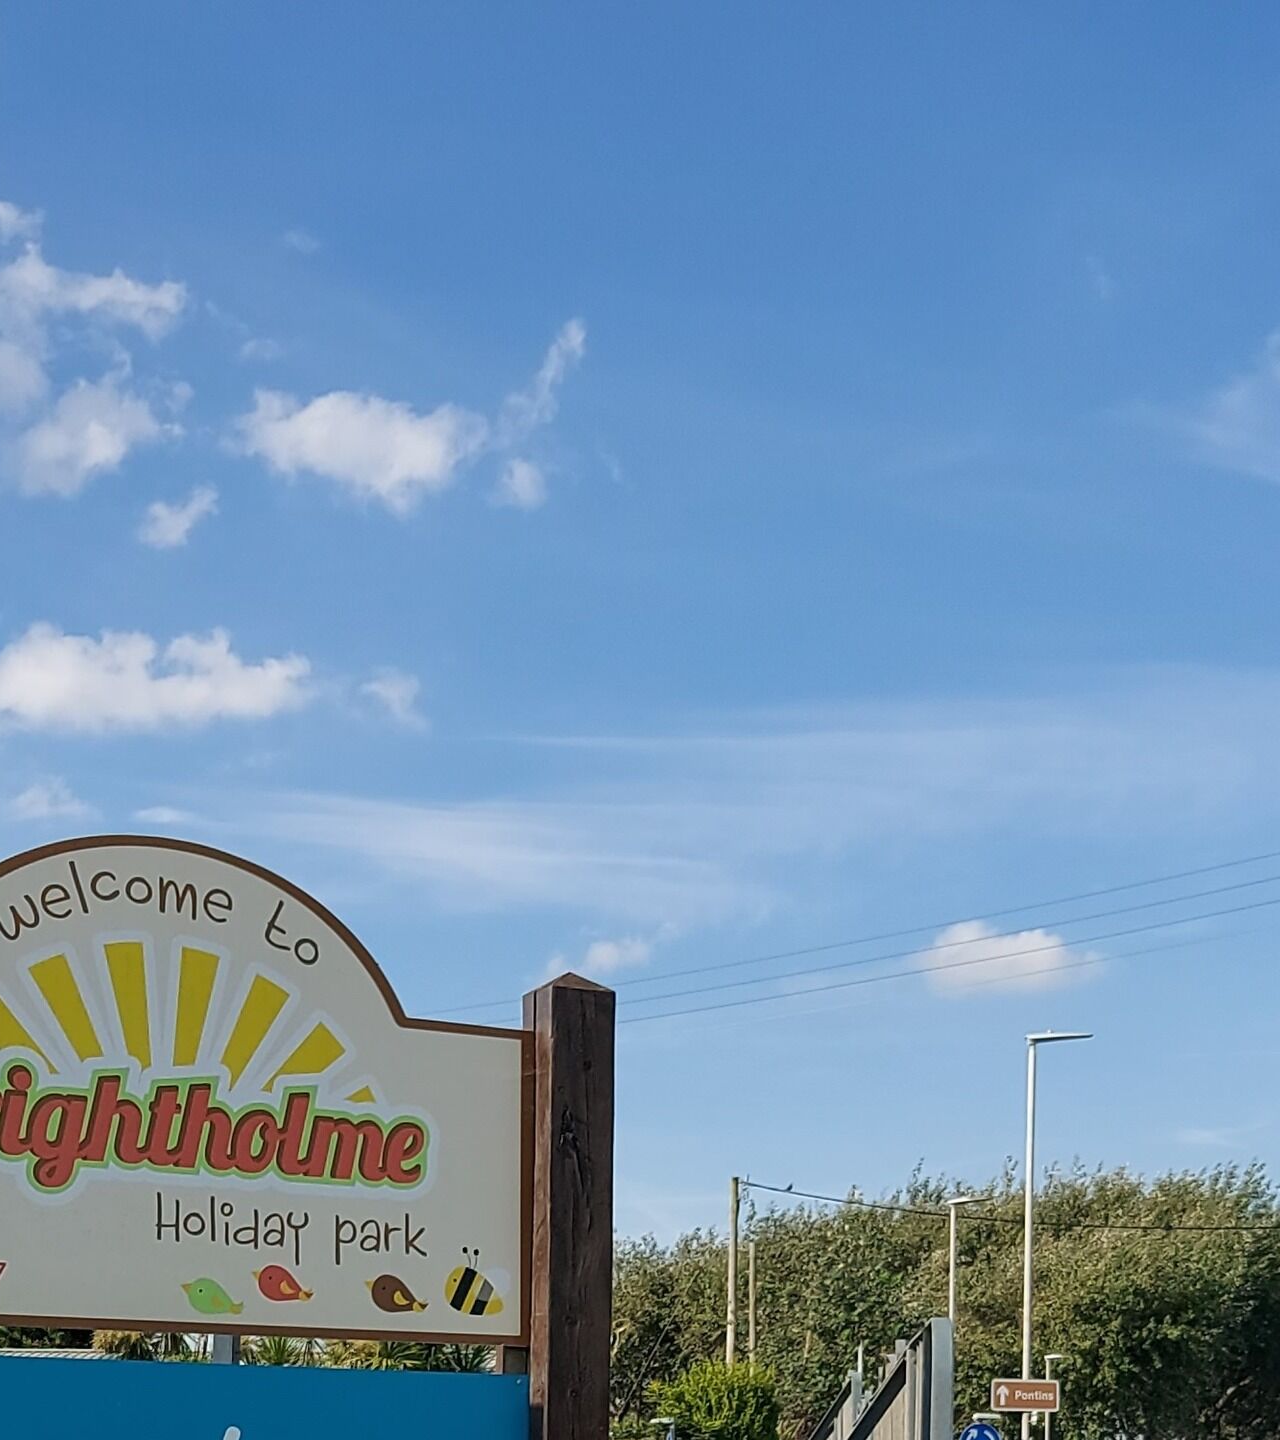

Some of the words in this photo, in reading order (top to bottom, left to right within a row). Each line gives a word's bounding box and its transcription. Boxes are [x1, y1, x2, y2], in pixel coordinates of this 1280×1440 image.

[267, 898, 321, 966] to
[156, 1192, 310, 1266] Holiday
[334, 1212, 428, 1265] park
[1014, 1389, 1055, 1401] Pontins
